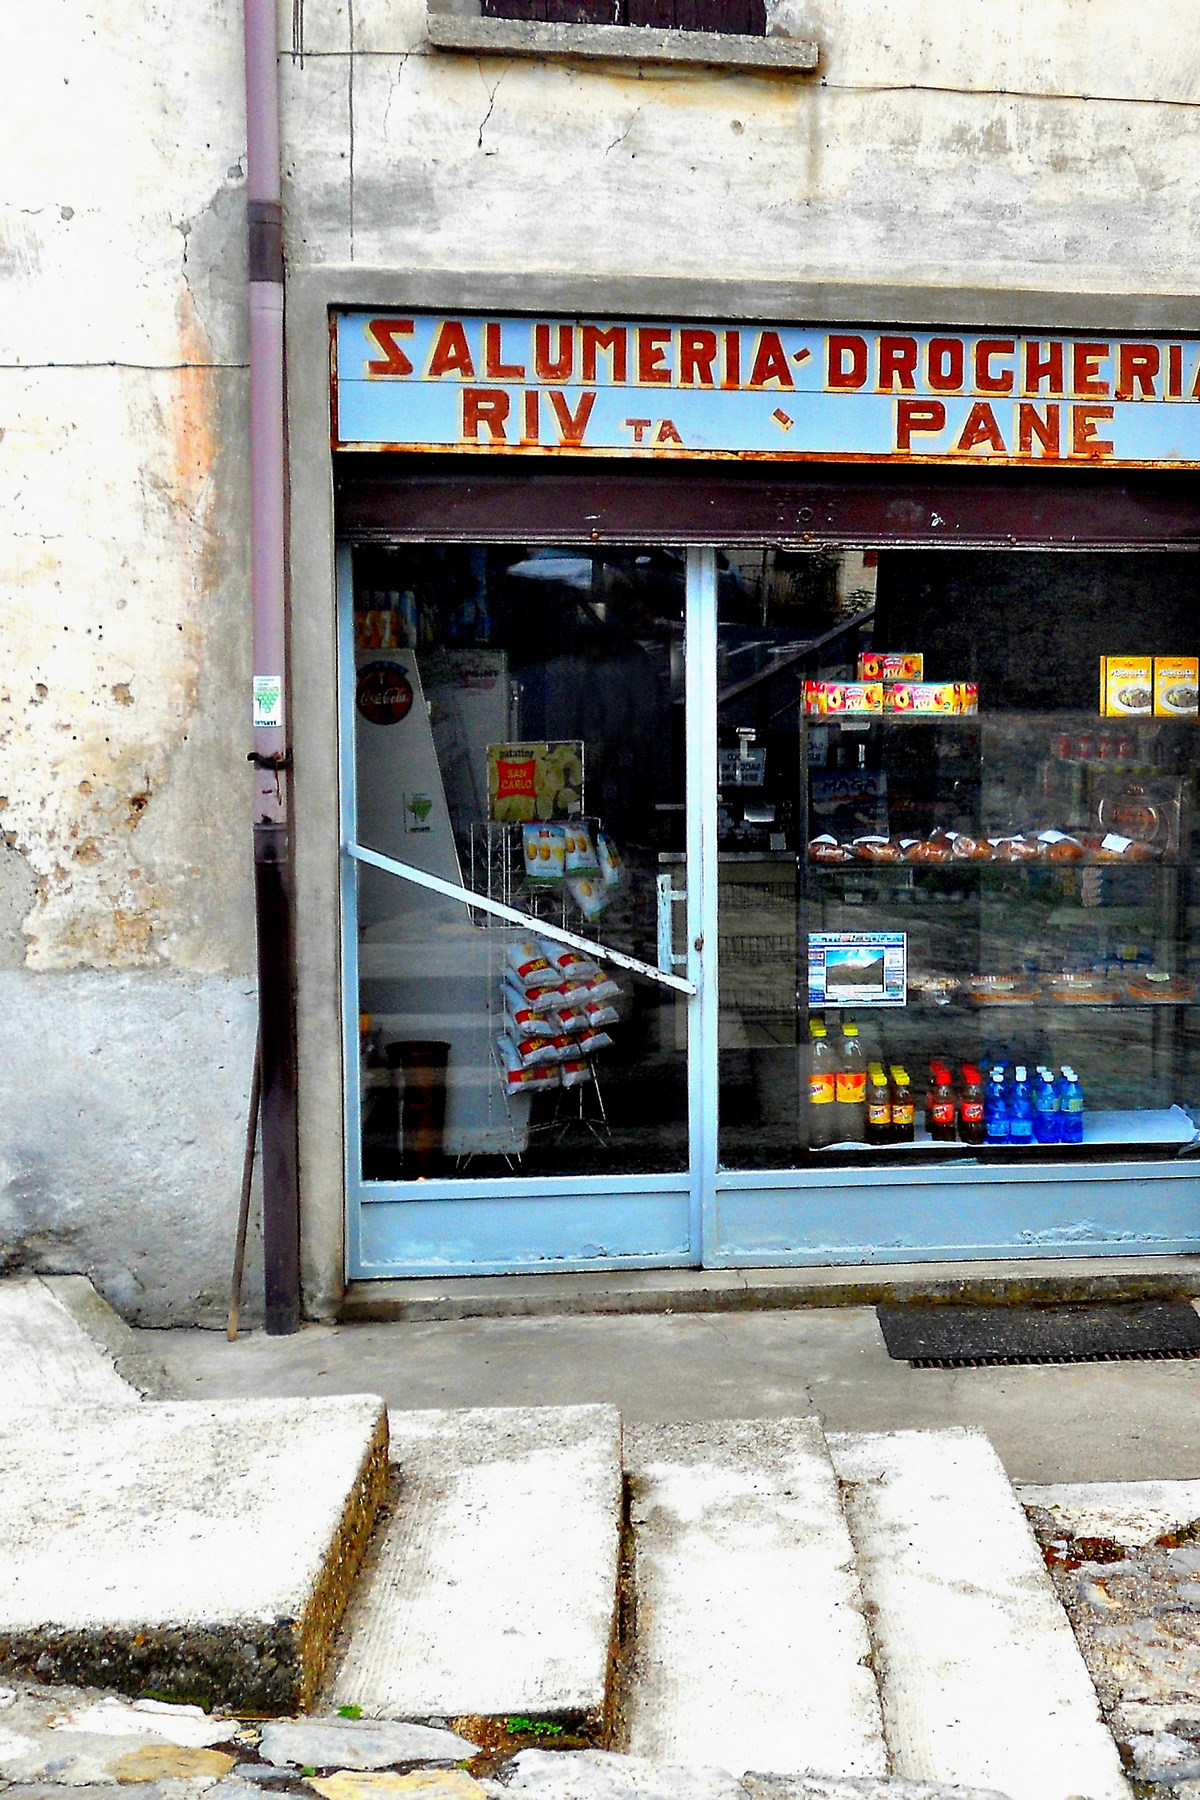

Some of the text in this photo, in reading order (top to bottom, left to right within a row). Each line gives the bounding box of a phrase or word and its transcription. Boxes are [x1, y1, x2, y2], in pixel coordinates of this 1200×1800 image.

[461, 388, 597, 444] RIV
[895, 399, 1115, 456] PANE
[359, 687, 408, 706] Coca-Cola
[506, 768, 527, 778] SAN
[501, 779, 532, 790] CARLO
